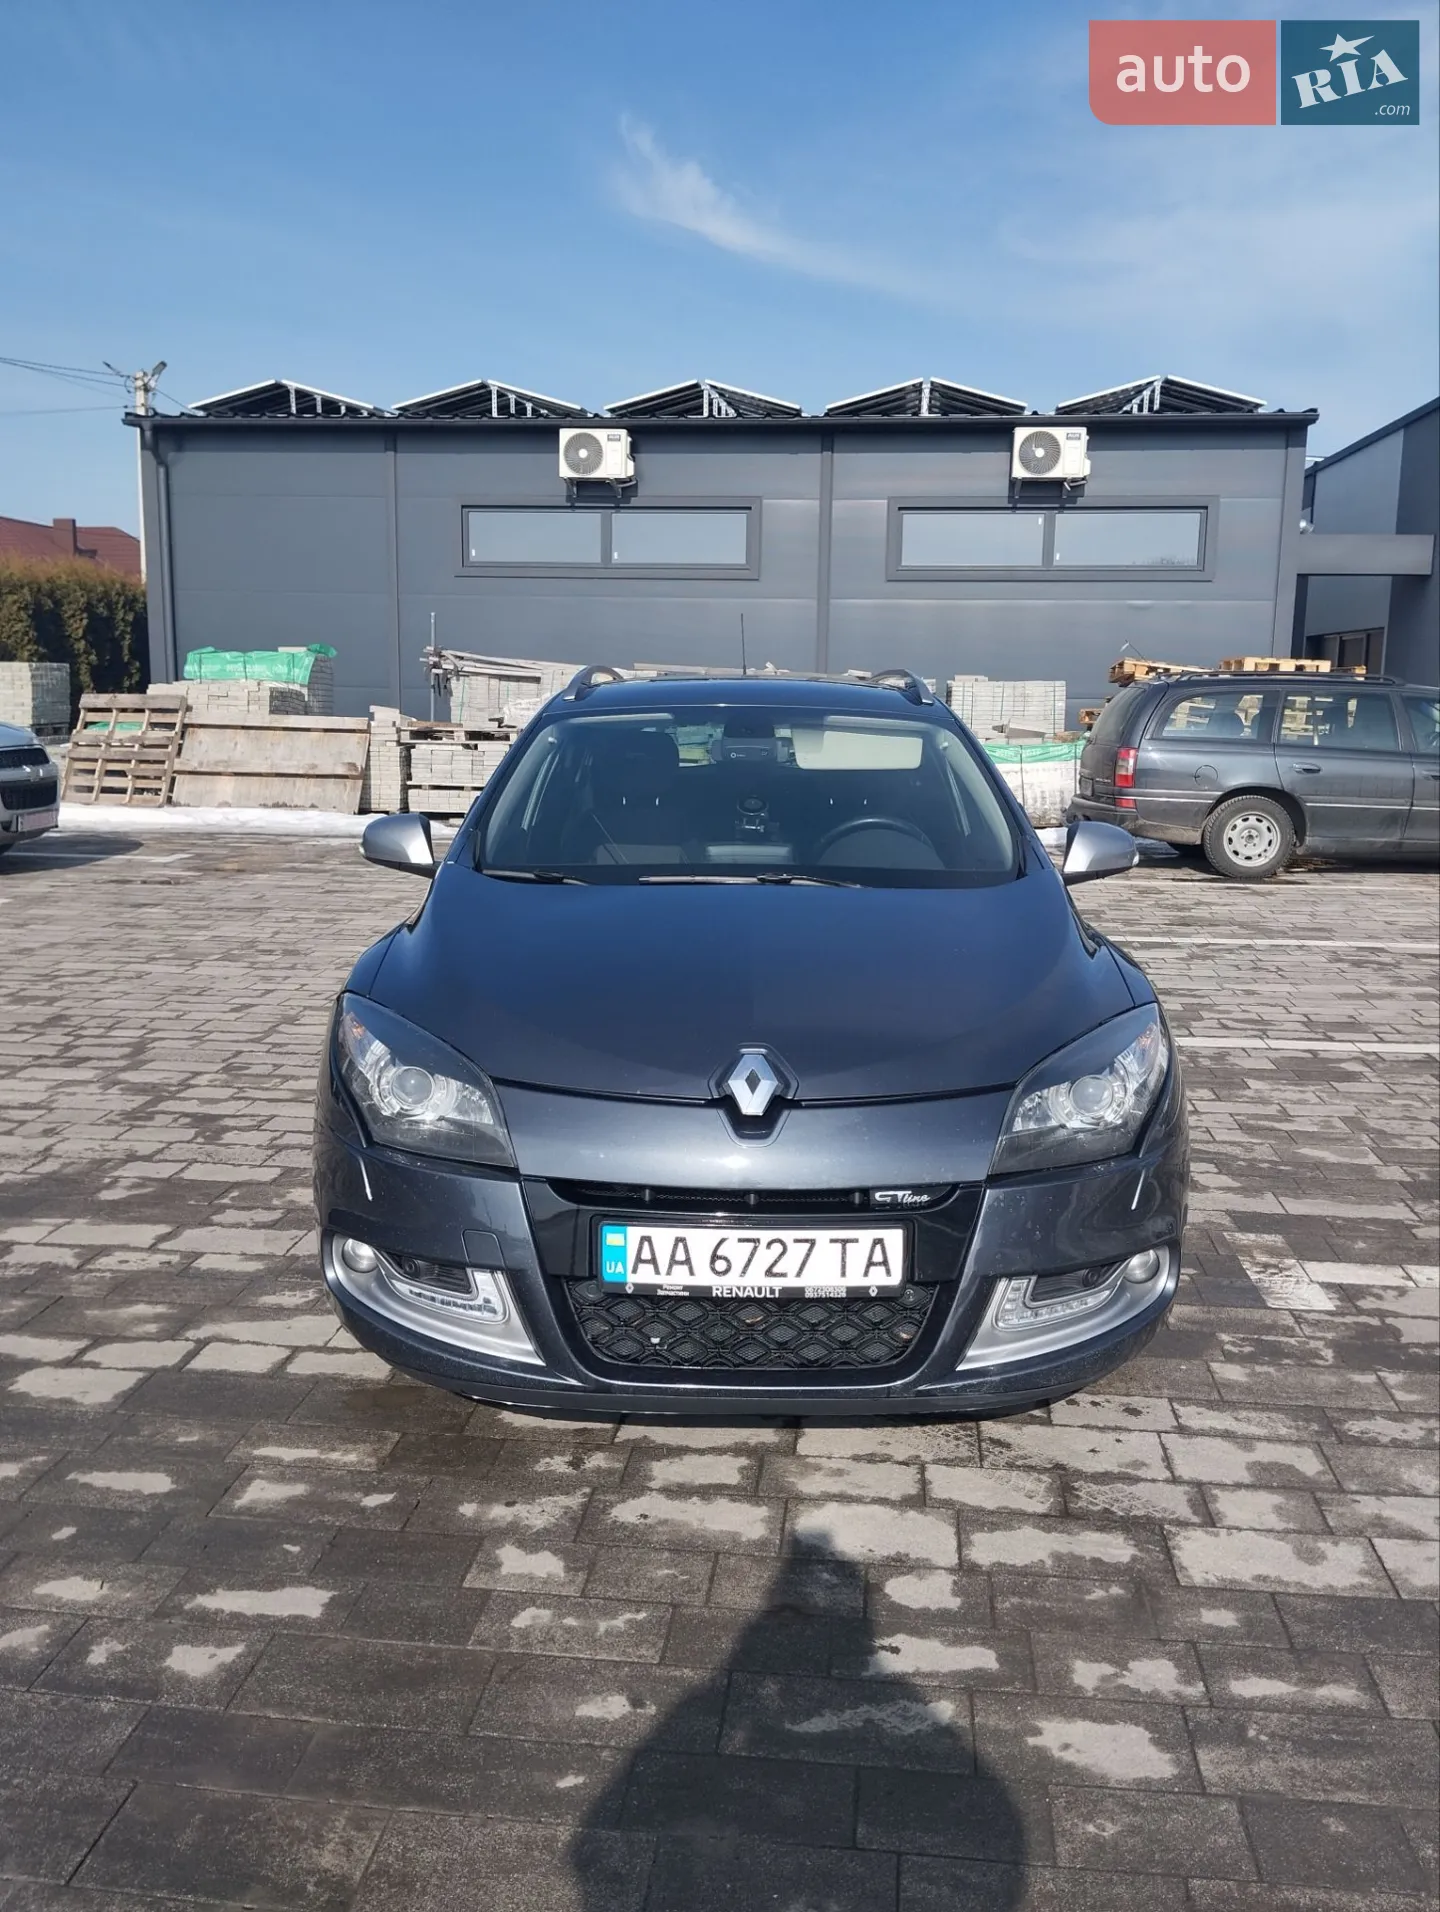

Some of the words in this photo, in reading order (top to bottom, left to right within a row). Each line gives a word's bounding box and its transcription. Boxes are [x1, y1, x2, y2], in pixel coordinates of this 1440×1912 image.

[631, 1235, 696, 1276] AA
[709, 1237, 817, 1278] 6727
[829, 1238, 891, 1277] TA
[606, 1261, 624, 1274] UA
[712, 1286, 783, 1298] RENAULT
